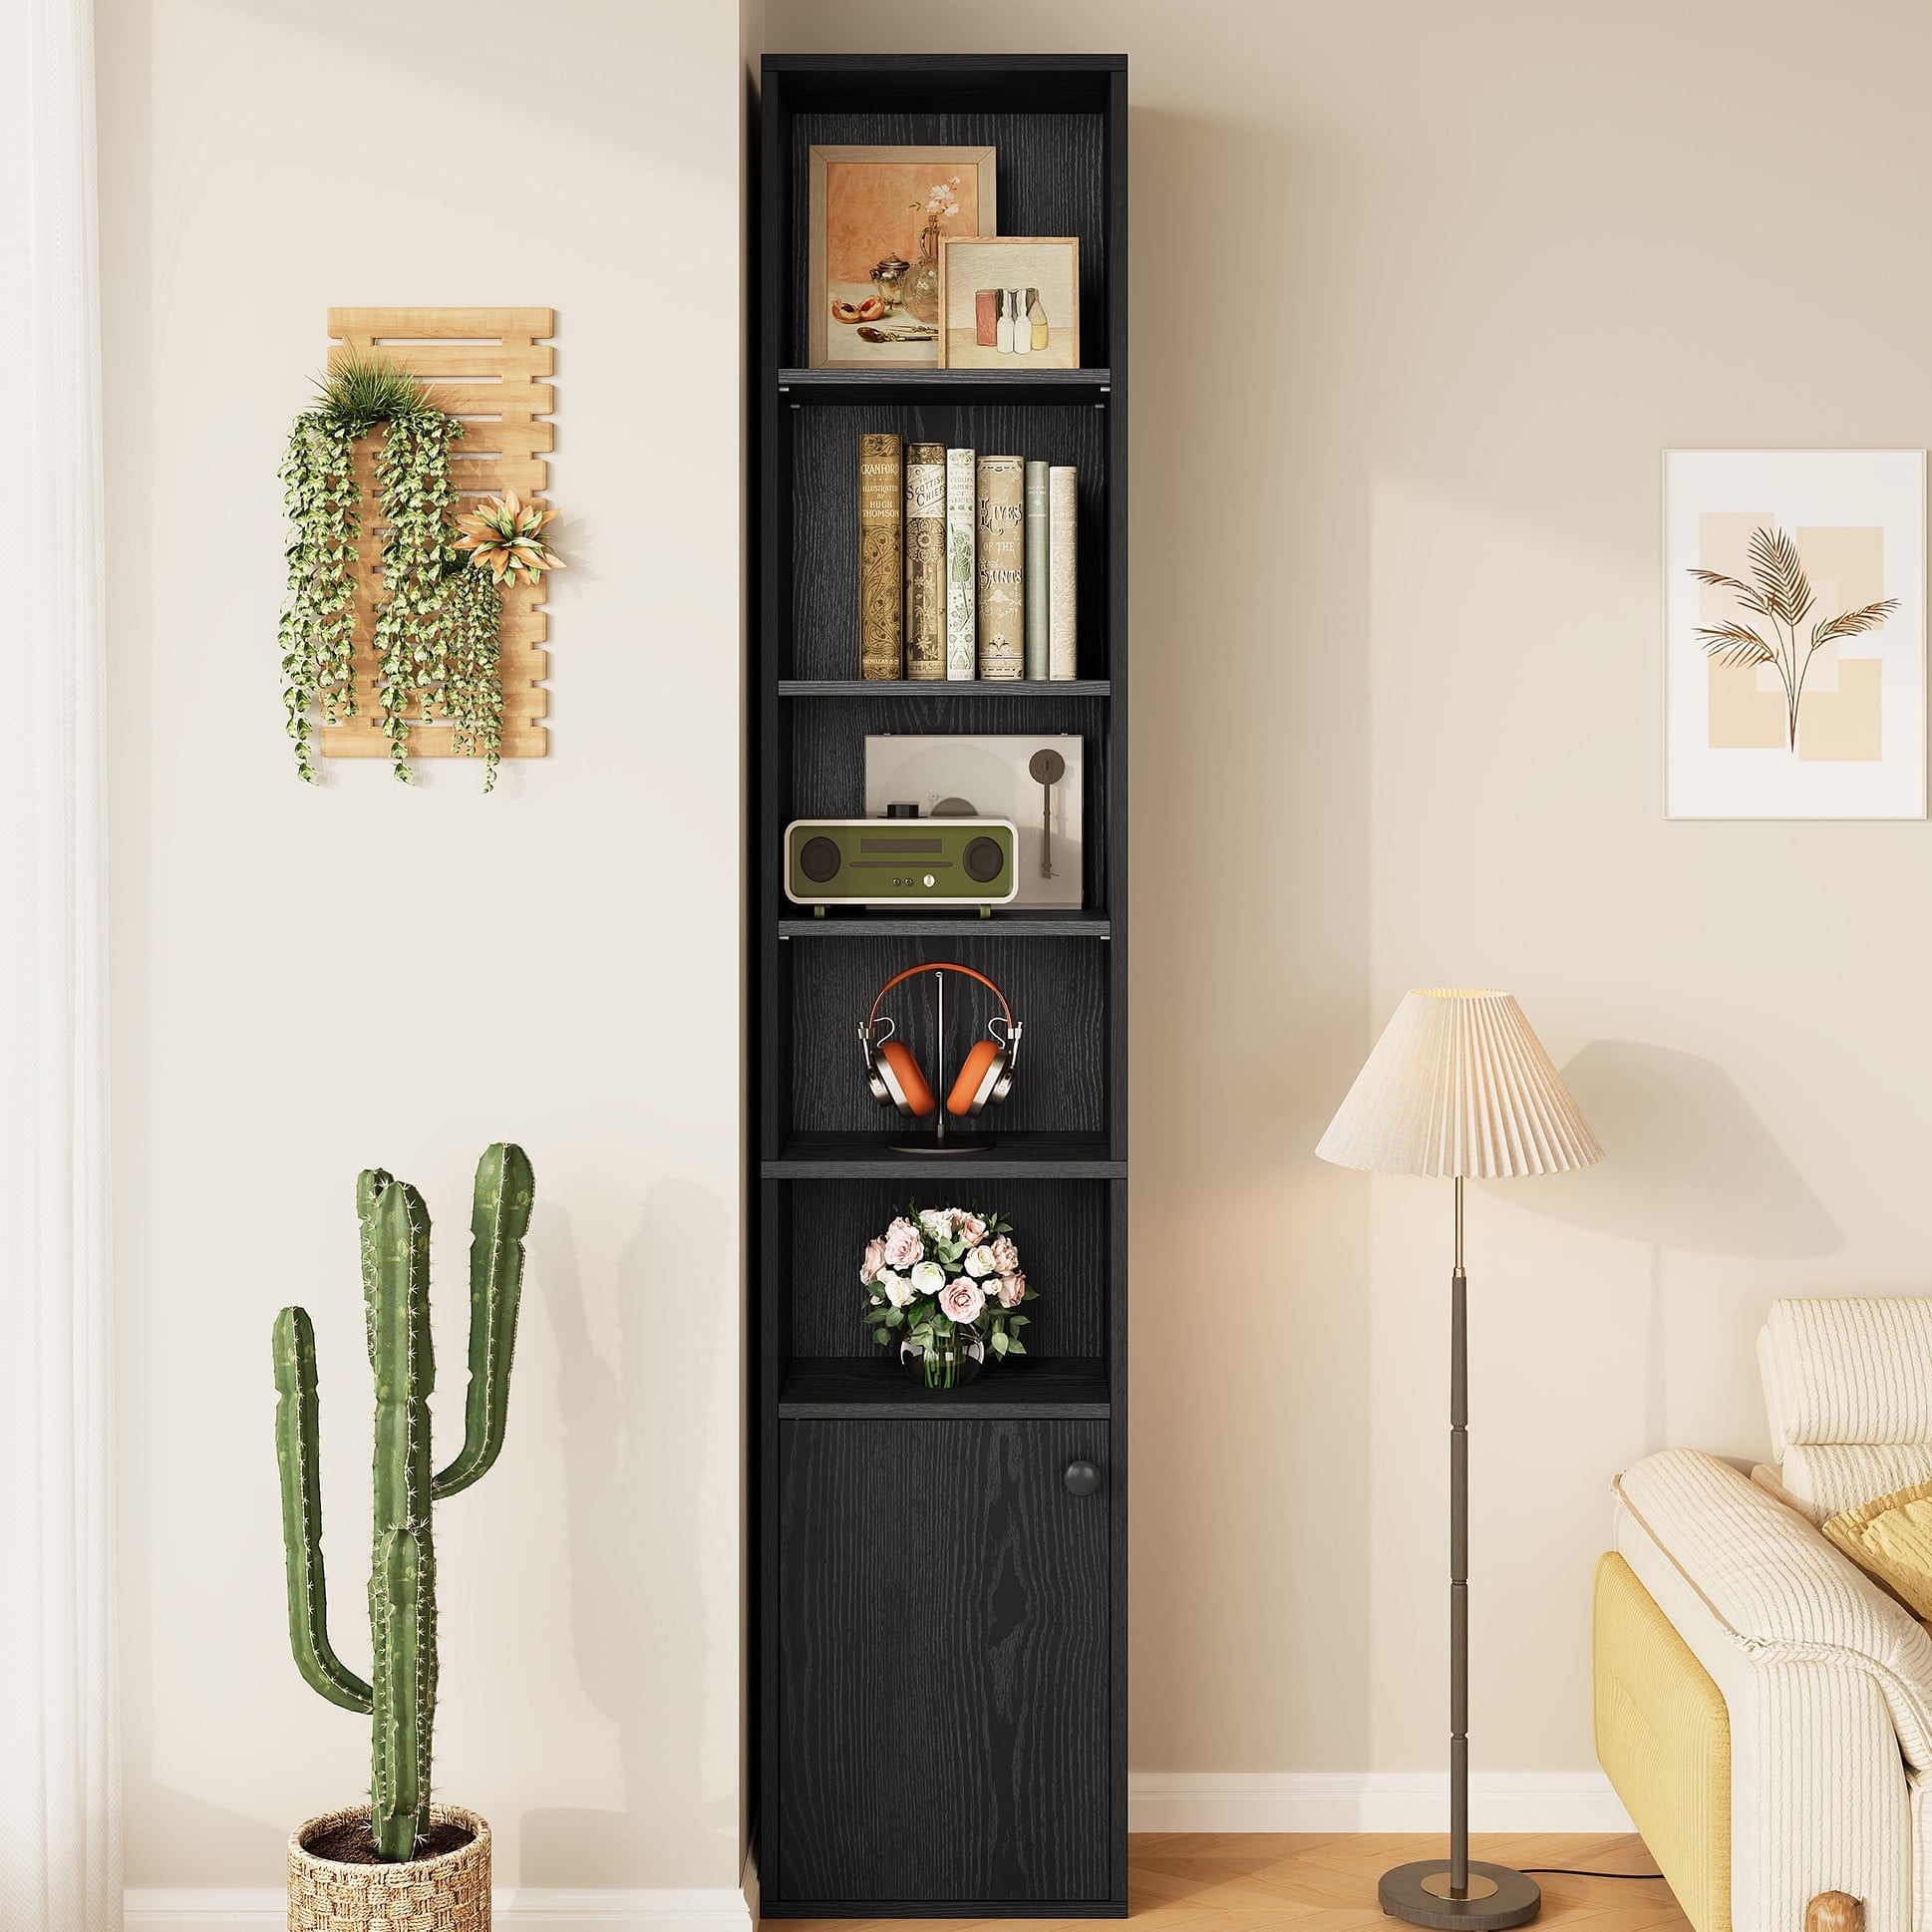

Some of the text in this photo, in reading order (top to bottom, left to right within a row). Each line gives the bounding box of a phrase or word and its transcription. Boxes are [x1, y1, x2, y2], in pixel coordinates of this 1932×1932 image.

[860, 464, 899, 477] CRANFORD
[862, 484, 899, 493] ILLUSTRATED
[862, 508, 900, 518] THOMSON
[980, 499, 1023, 536] LIVES
[983, 541, 1017, 559] OF THE
[979, 559, 1023, 590] SAINTS
